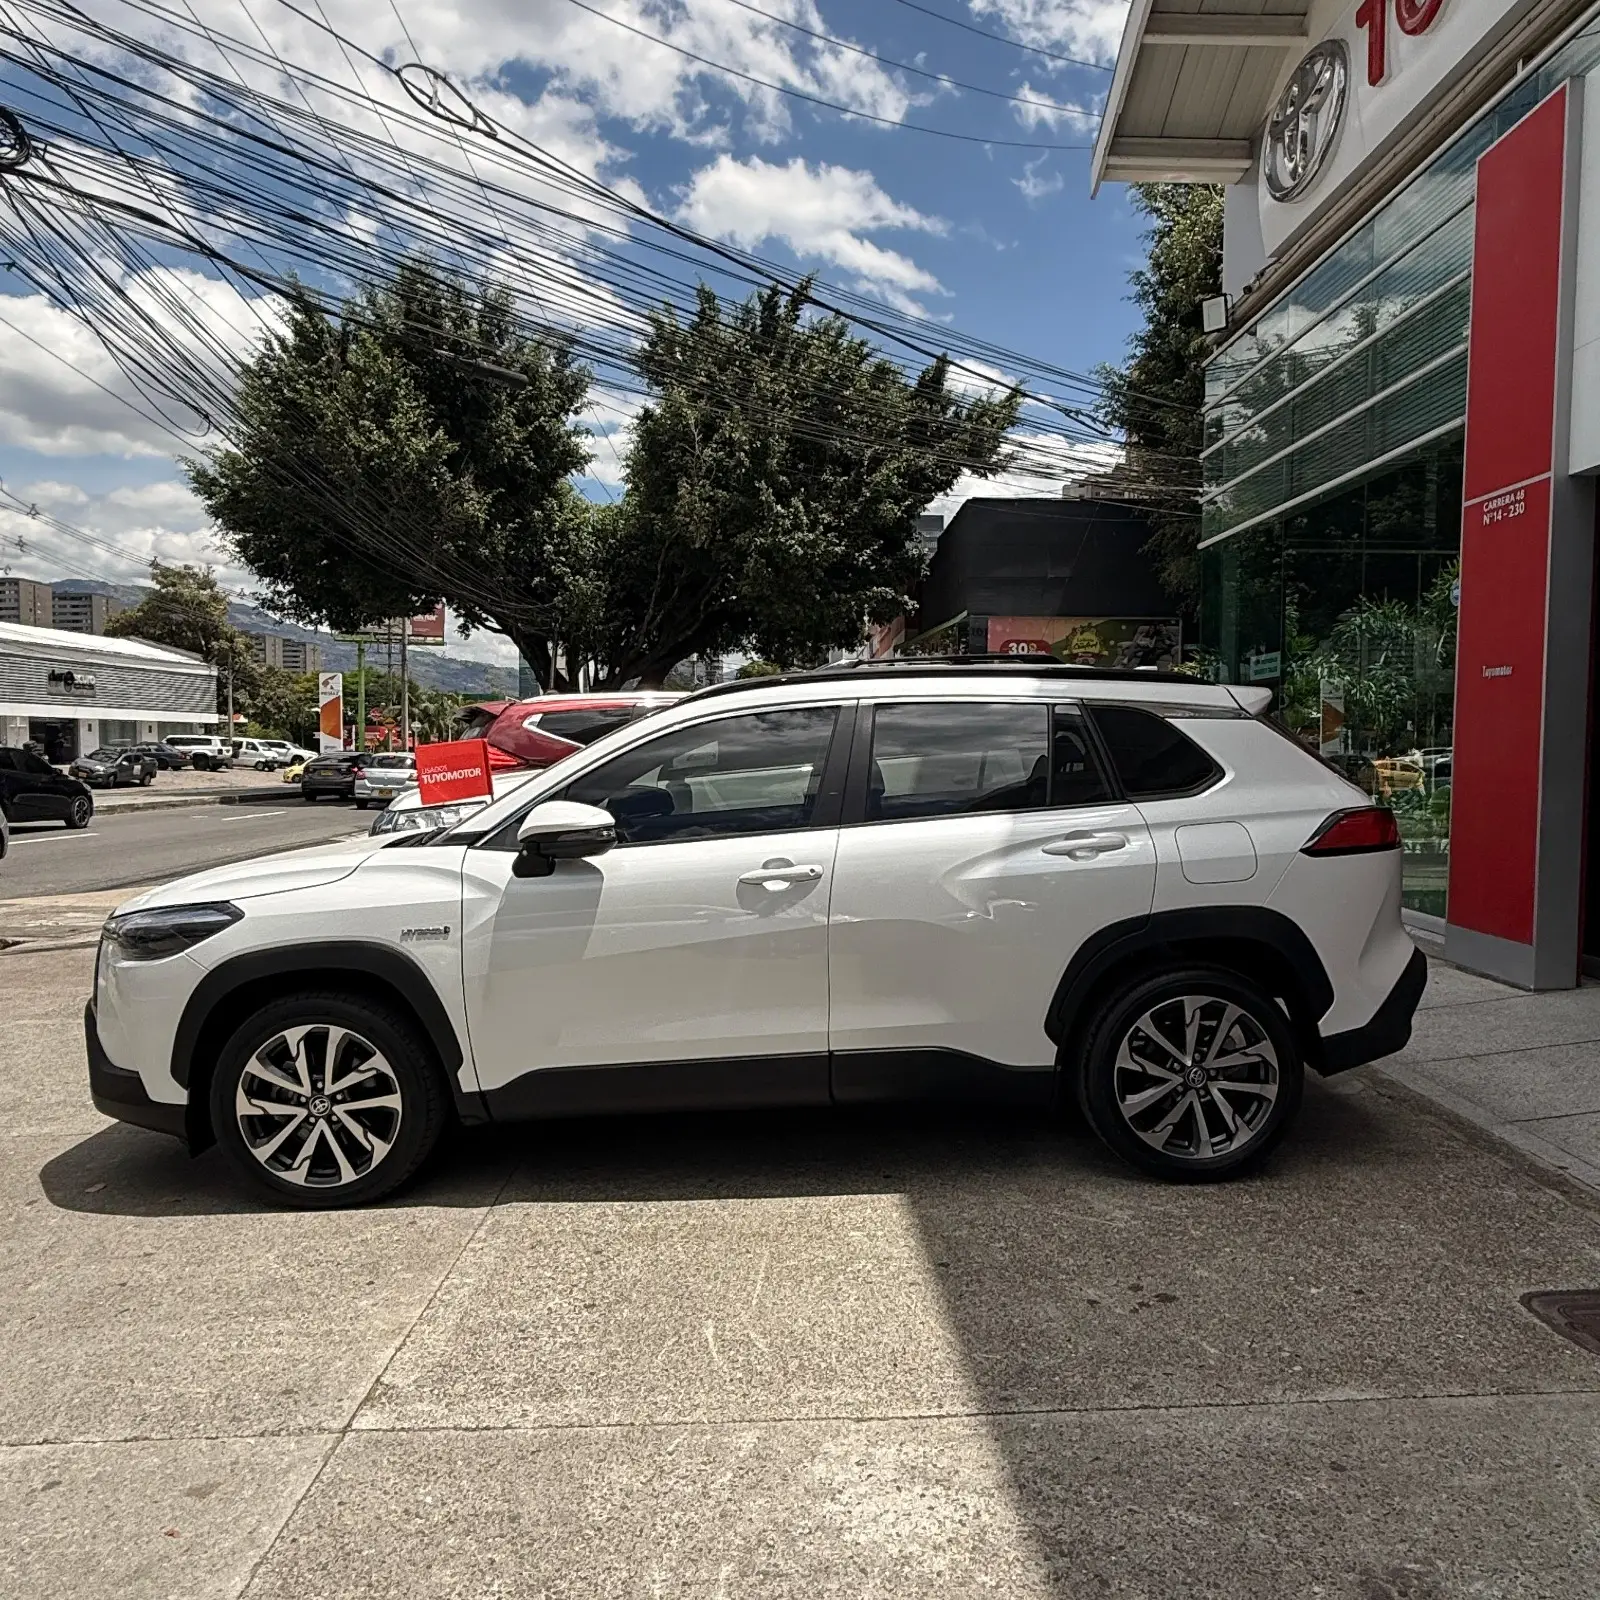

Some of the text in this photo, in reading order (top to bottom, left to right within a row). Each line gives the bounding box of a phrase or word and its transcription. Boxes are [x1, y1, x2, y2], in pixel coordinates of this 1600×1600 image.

[1483, 493, 1515, 512] CARRERA
[421, 764, 448, 775] USADOS
[421, 767, 482, 785] TUYOMOTOR
